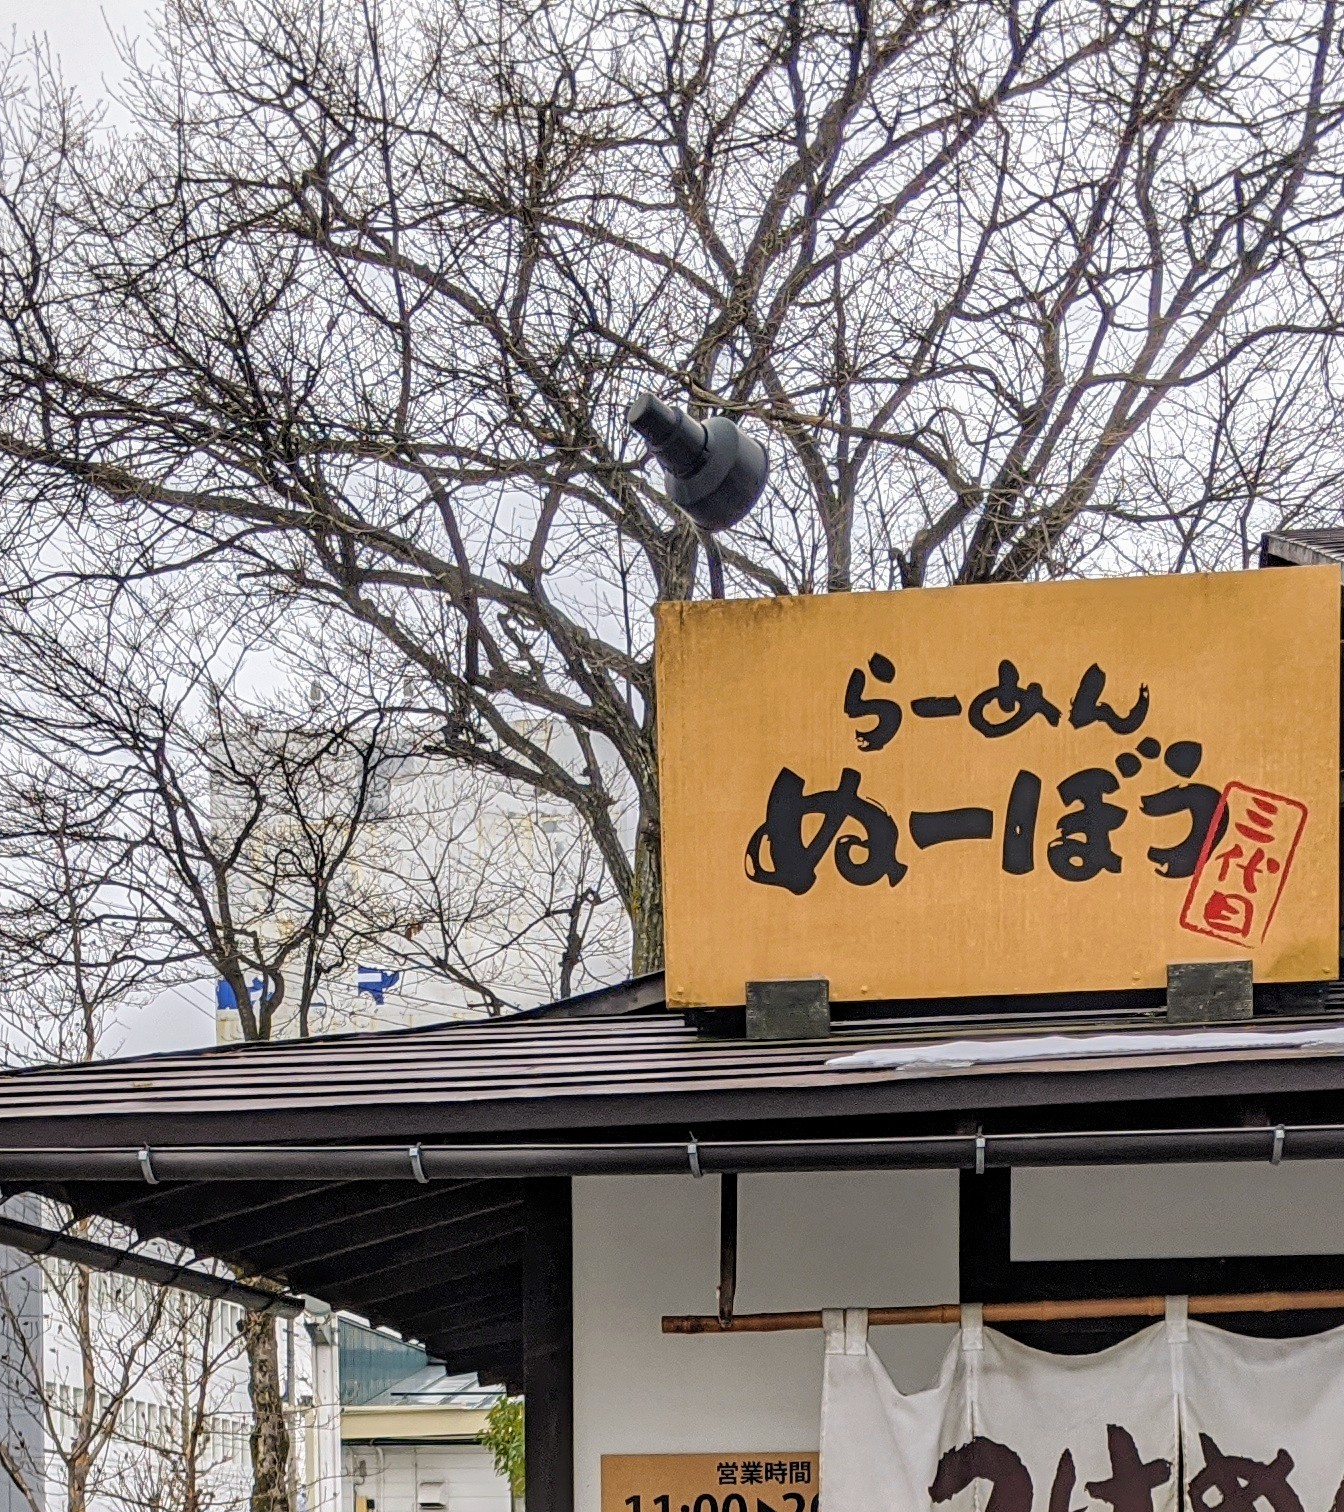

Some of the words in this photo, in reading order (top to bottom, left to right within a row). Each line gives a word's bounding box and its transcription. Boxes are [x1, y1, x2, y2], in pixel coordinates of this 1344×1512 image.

[844, 651, 1149, 752] らーめん
[744, 736, 1230, 896] ぬーぼう
[1202, 796, 1280, 938] 三代目
[717, 1460, 812, 1486] 営業時間
